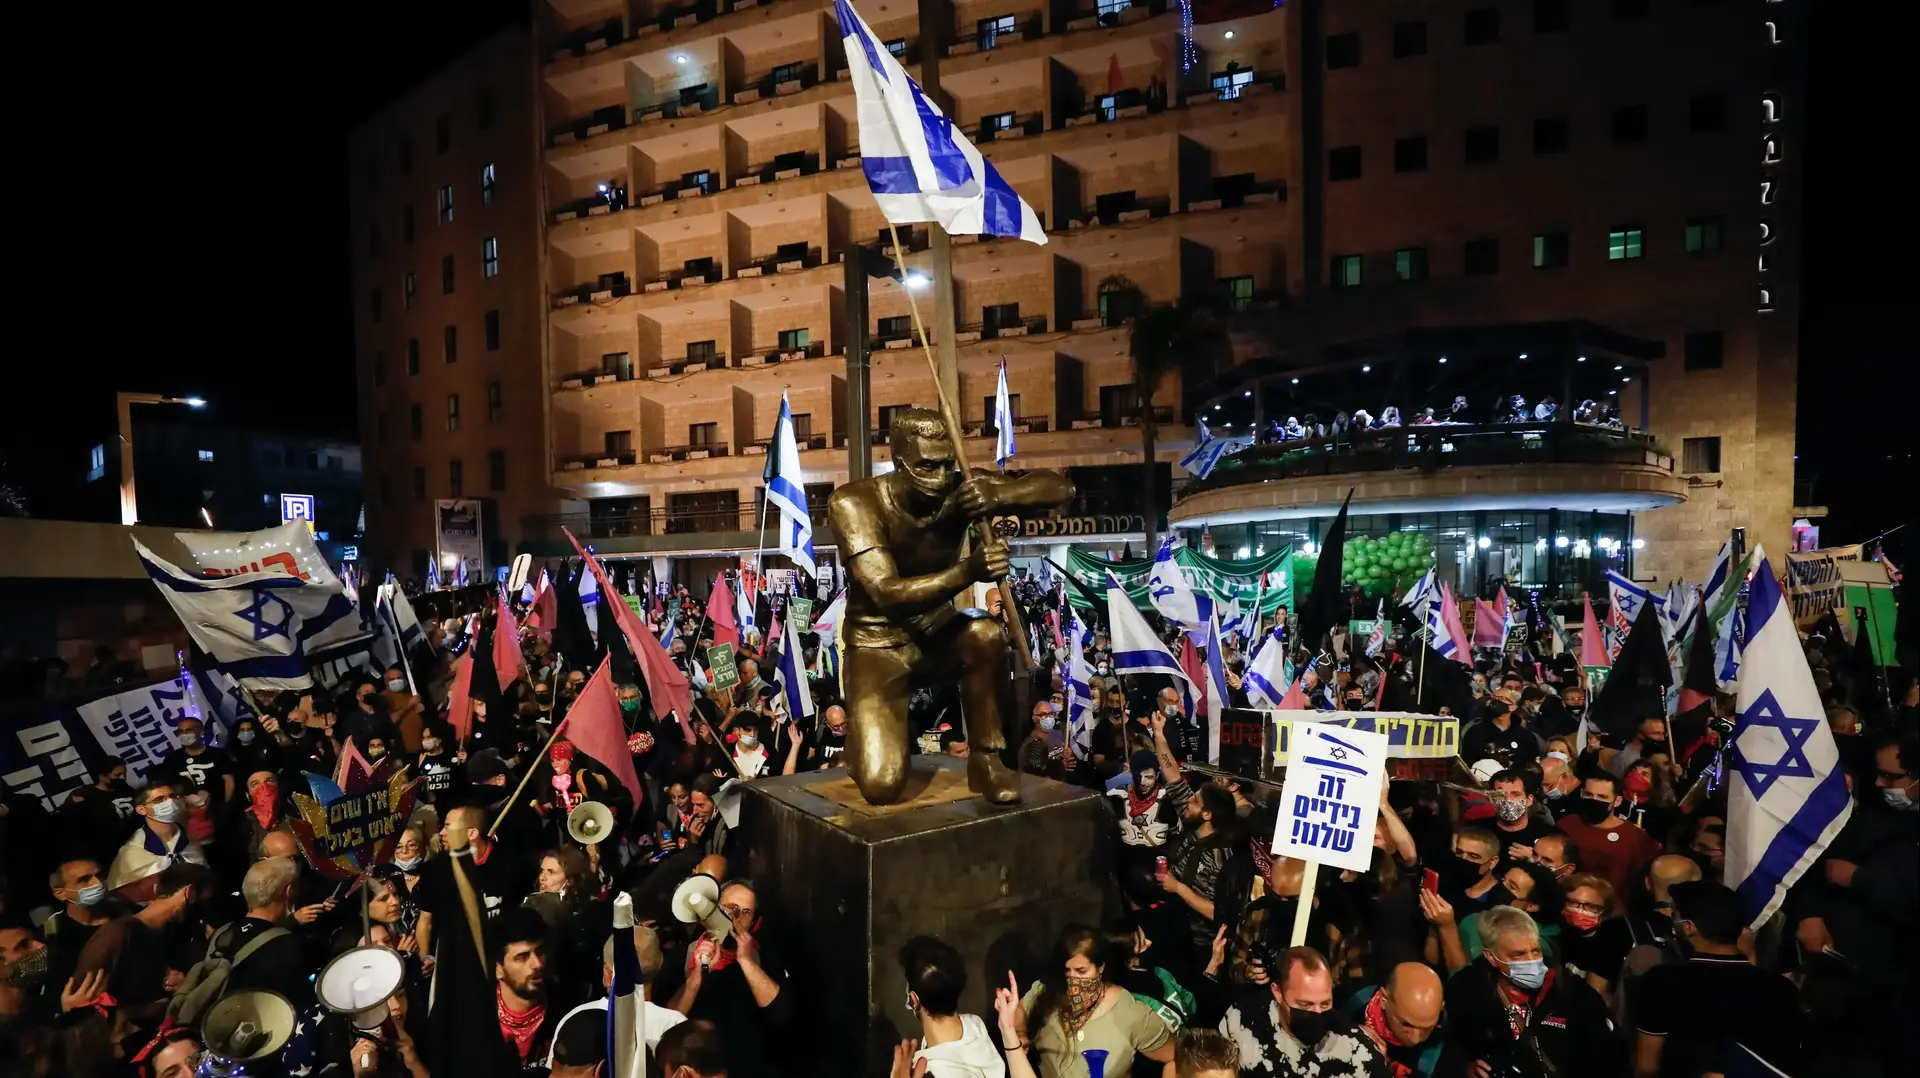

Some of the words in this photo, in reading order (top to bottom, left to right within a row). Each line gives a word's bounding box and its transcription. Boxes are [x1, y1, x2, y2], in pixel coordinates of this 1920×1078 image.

[1024, 514, 1097, 536] המלכים
[1103, 514, 1146, 533] רימה
[713, 662, 734, 674] להצביע
[717, 670, 735, 683] מרצ
[427, 773, 450, 783] חקיר
[429, 782, 450, 791] עכש
[1317, 774, 1346, 800] זה
[331, 797, 362, 824] שום
[365, 789, 388, 814] אין
[1293, 795, 1361, 829] בידיים
[1290, 819, 1355, 853] שלנו!
